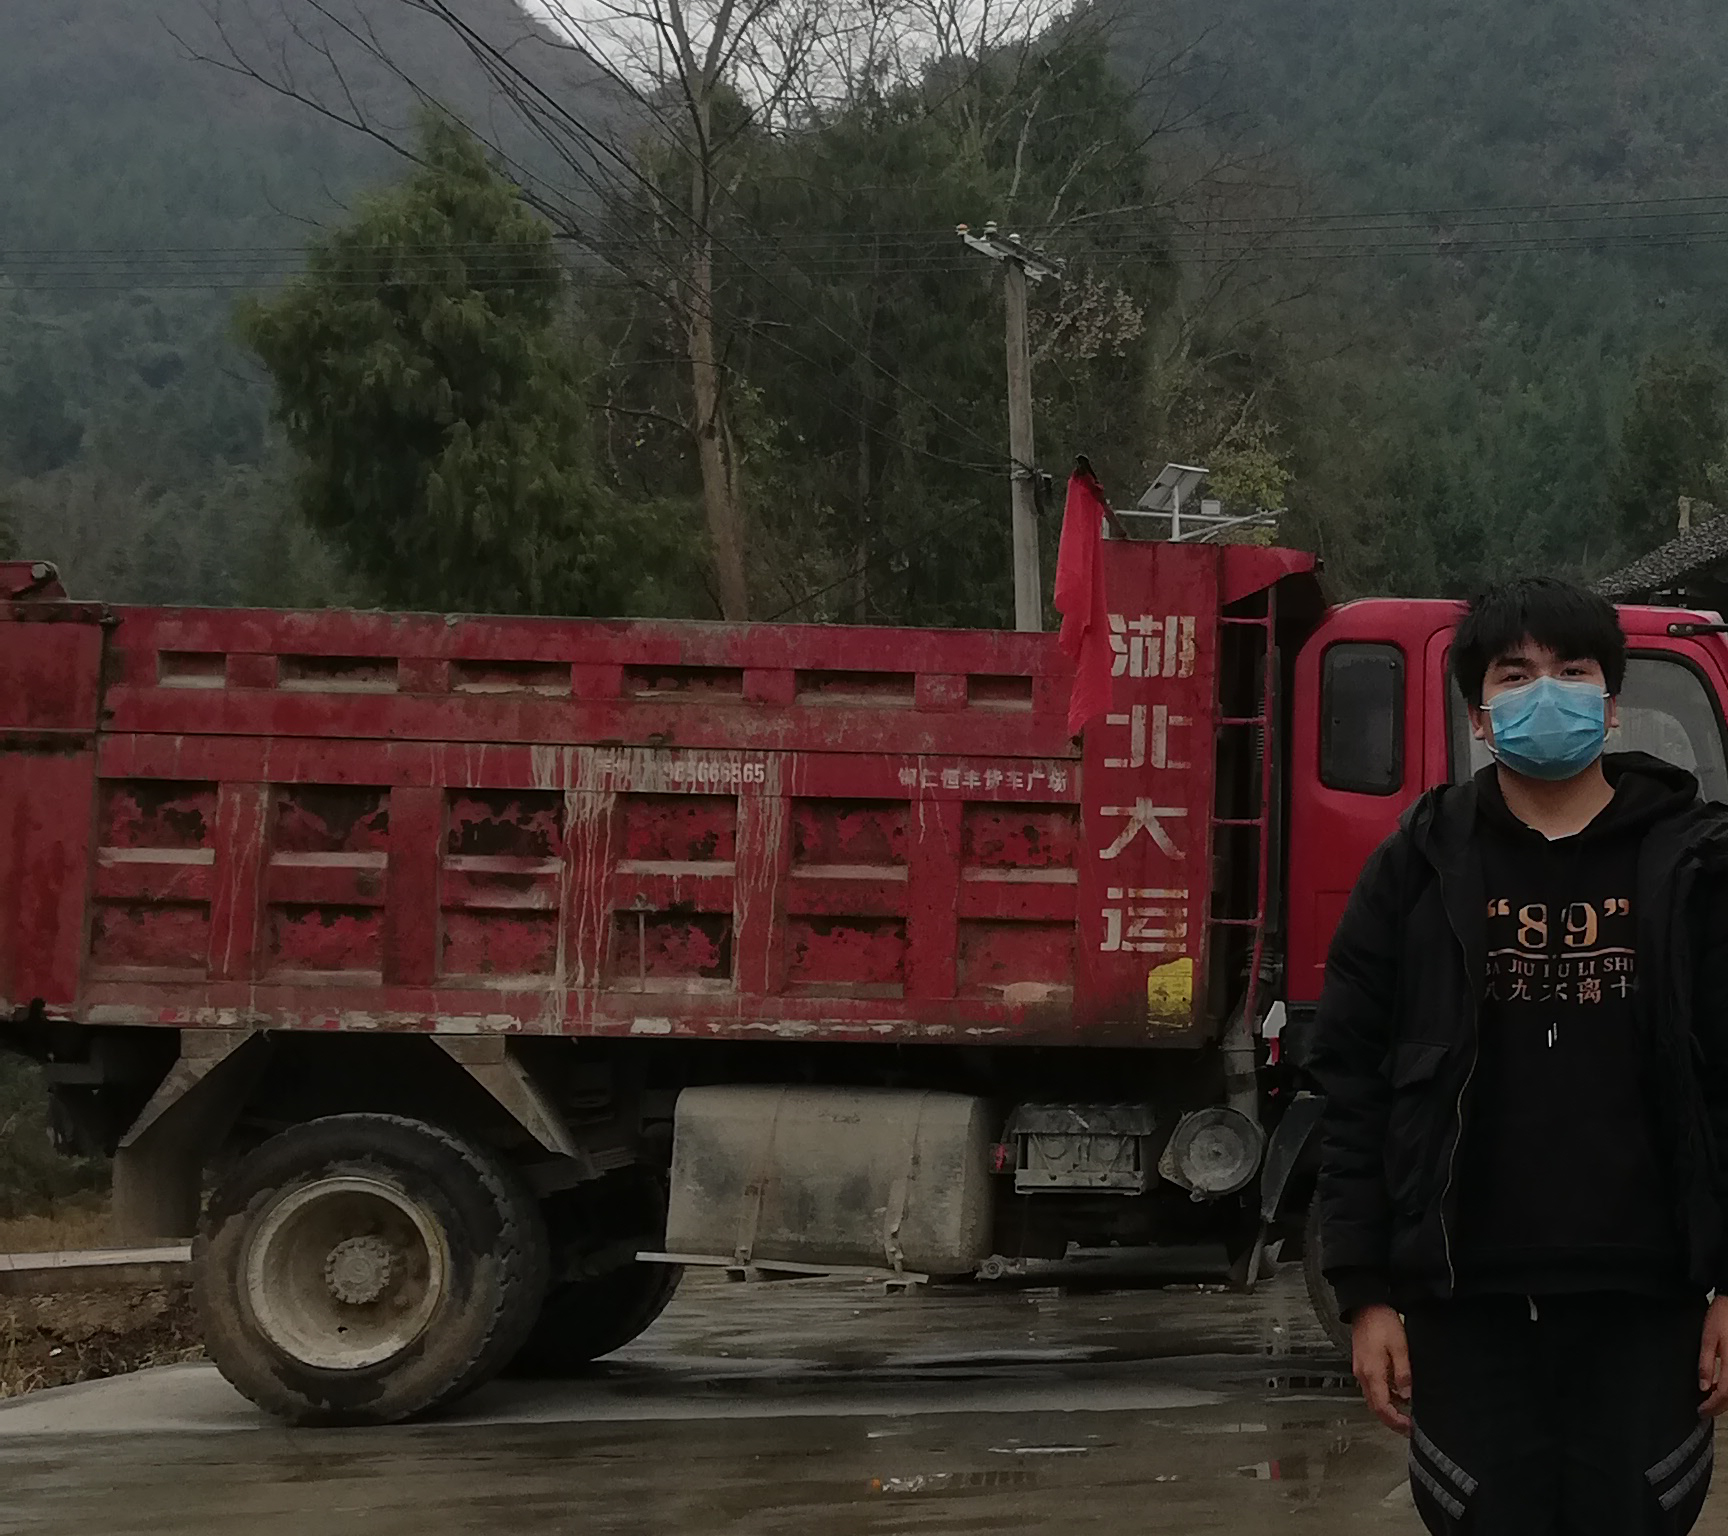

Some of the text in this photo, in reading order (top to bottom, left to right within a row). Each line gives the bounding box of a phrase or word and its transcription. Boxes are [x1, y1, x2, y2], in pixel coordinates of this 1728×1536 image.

[1098, 613, 1197, 953] 湖北大运
[1508, 959, 1536, 976] JIU
[1578, 960, 1595, 976] LI
